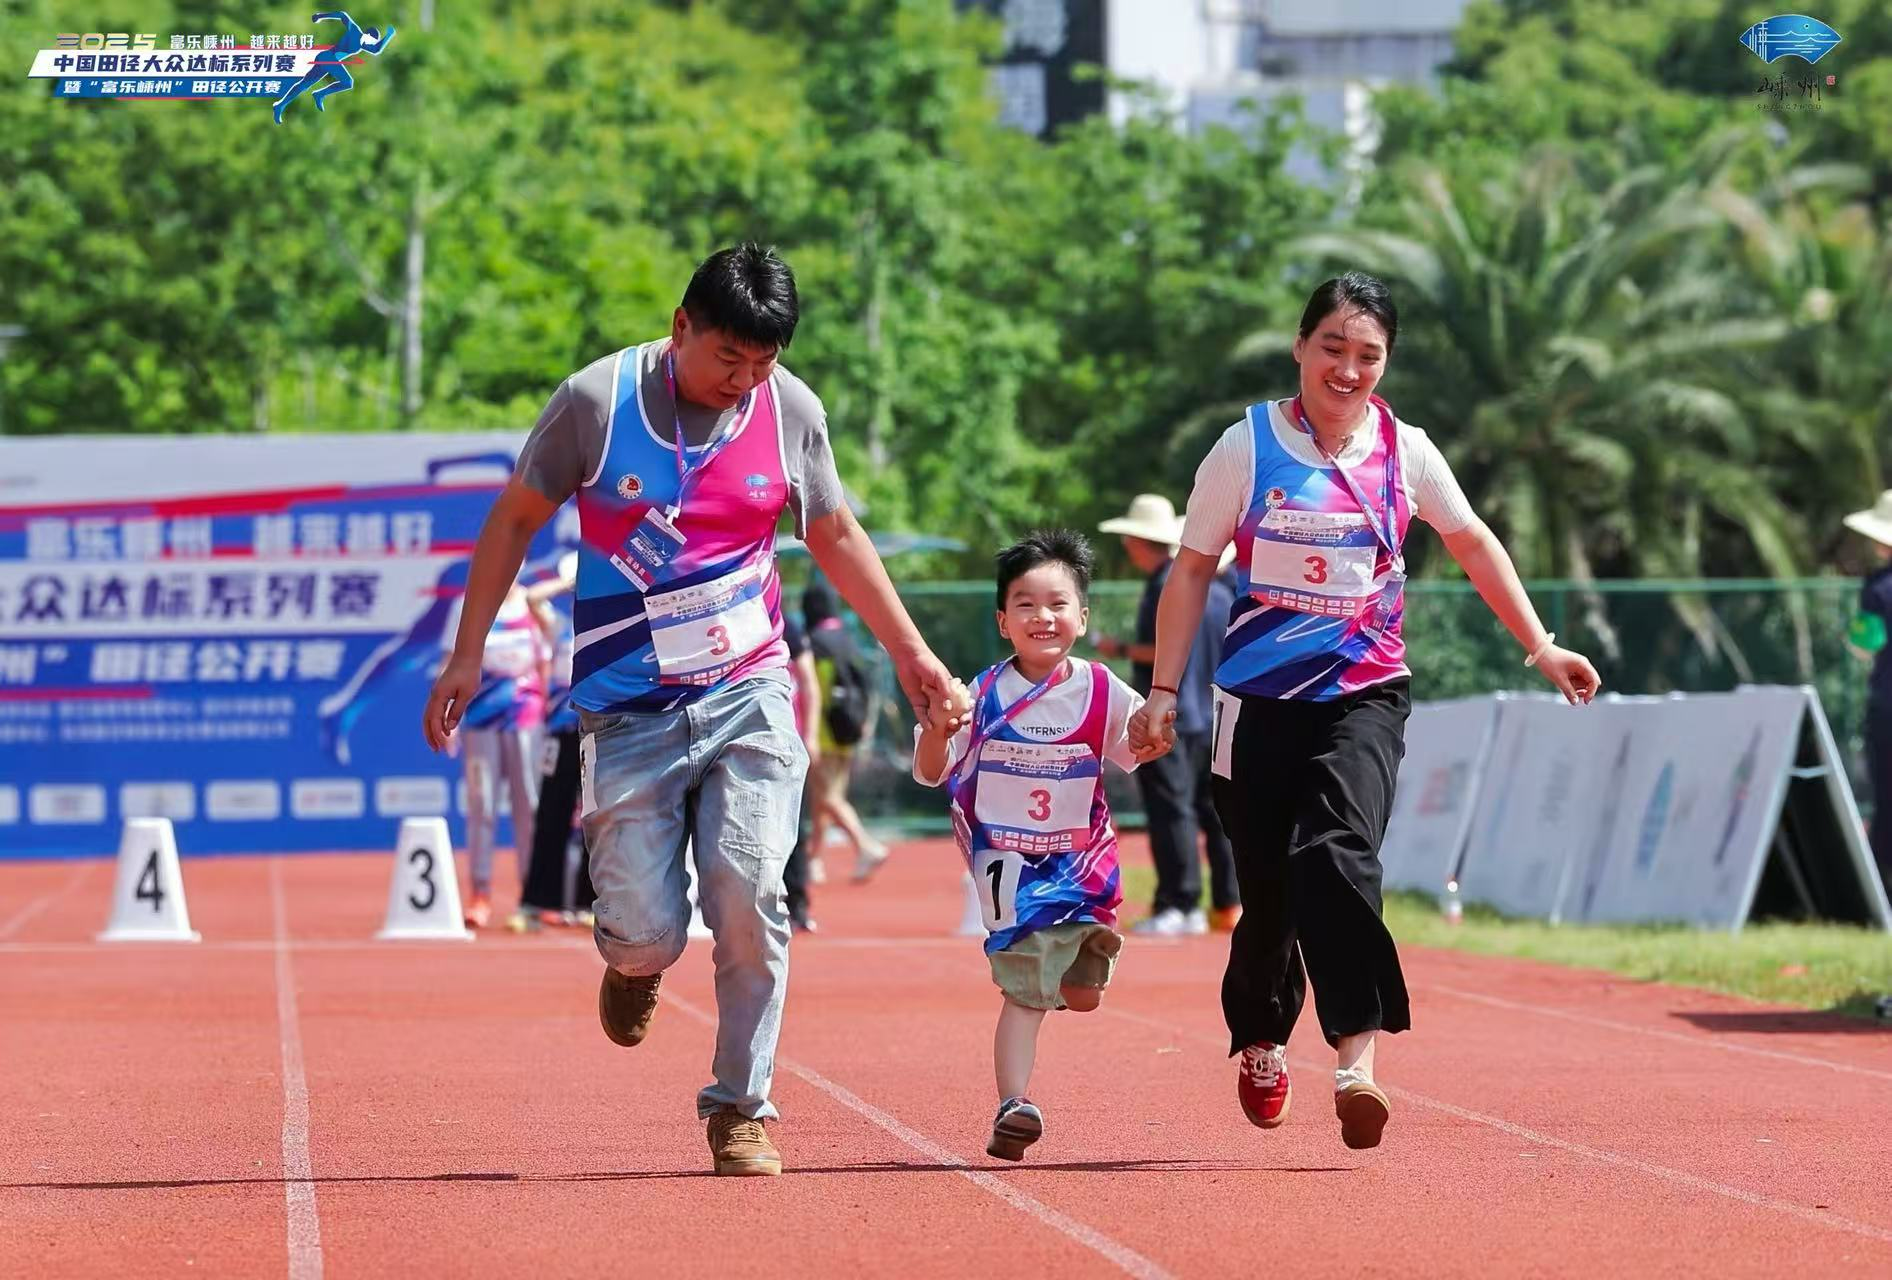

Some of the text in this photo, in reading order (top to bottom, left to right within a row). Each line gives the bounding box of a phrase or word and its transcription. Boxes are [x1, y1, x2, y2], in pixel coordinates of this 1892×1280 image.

[1304, 555, 1327, 584] 3
[707, 625, 729, 655] 3
[1028, 789, 1051, 821] 3
[136, 850, 164, 911] 4
[409, 848, 435, 910] 3
[986, 859, 1004, 921] 1
